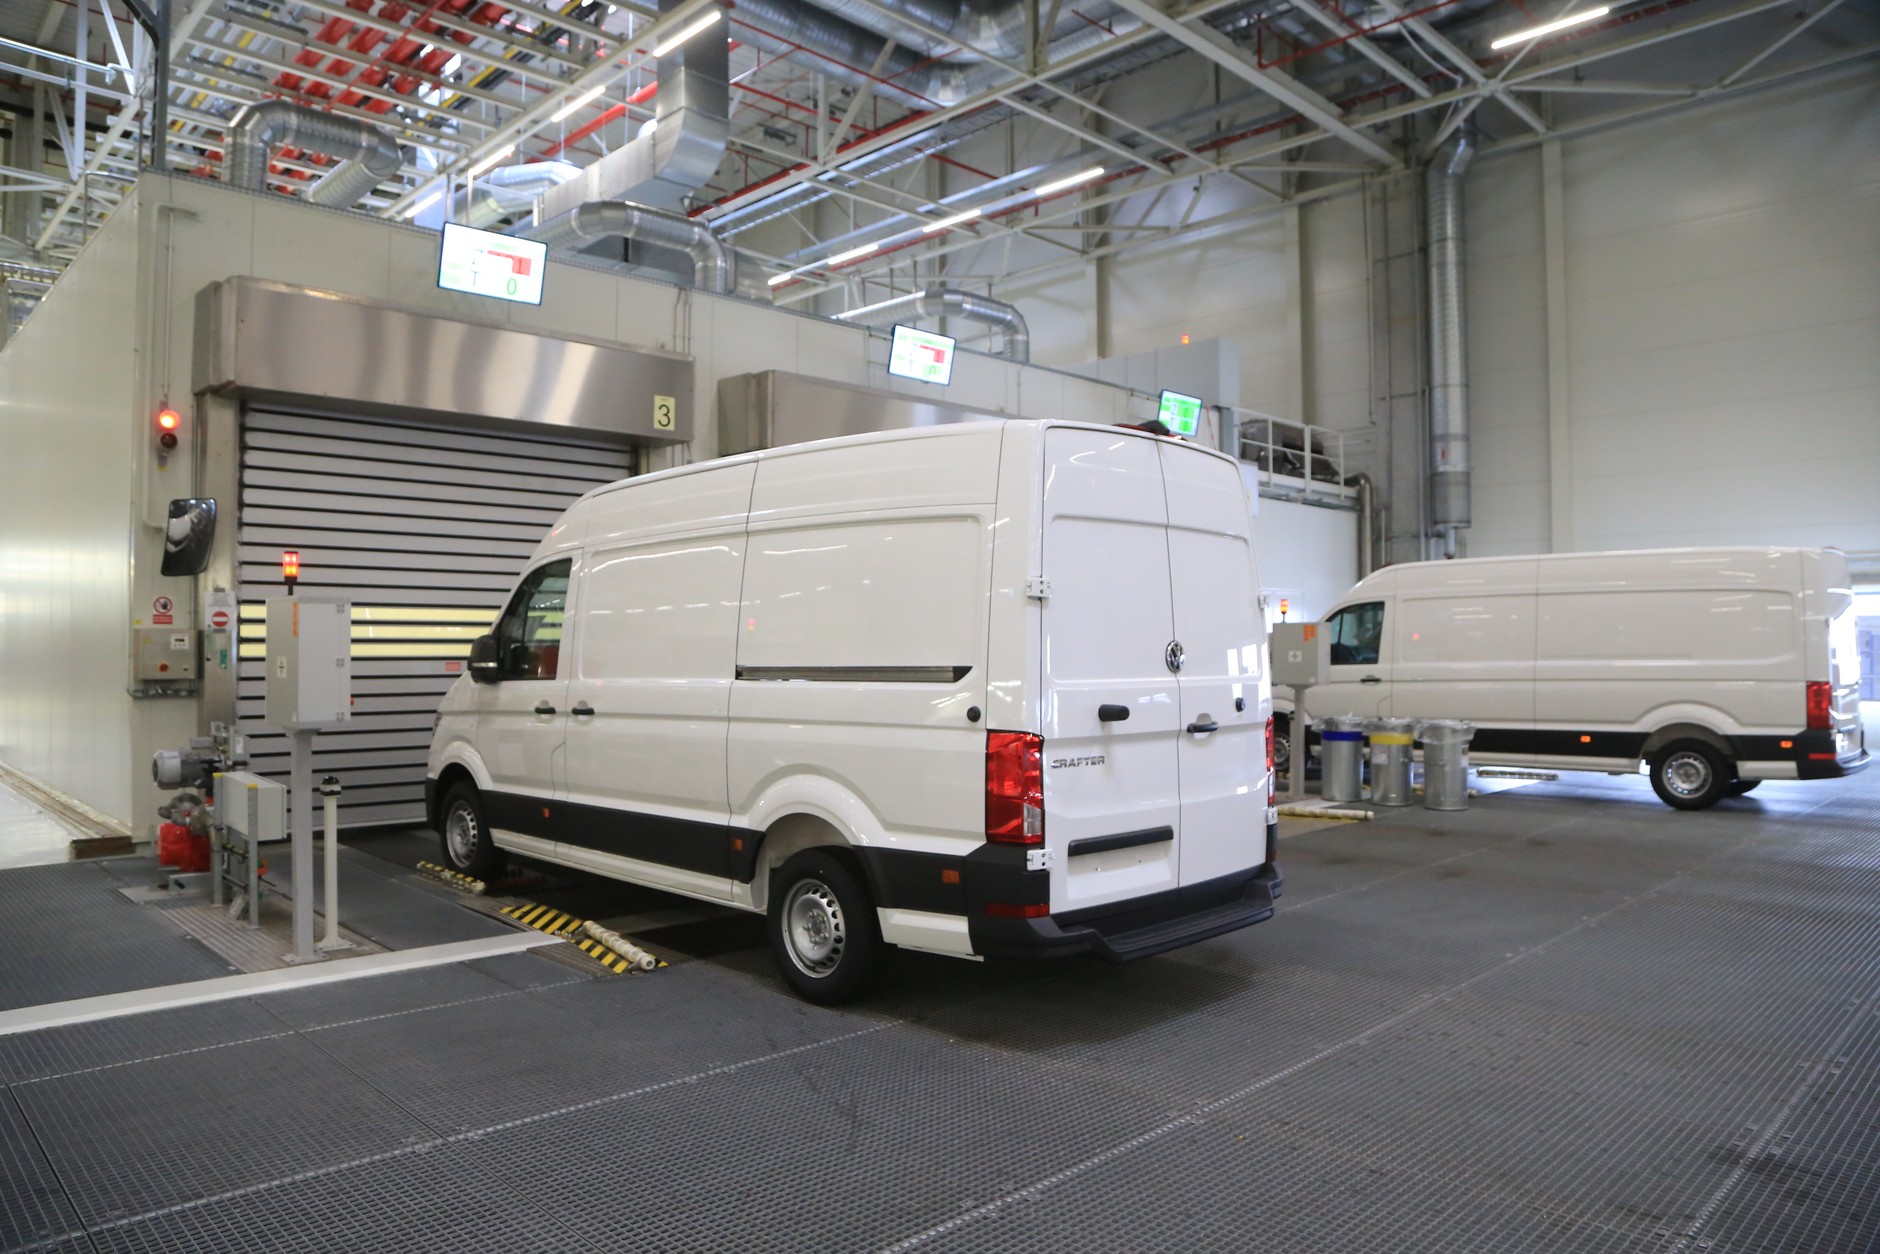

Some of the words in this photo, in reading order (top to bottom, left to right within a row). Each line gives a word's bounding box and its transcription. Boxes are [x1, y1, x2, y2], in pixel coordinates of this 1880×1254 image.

[506, 278, 518, 296] 0
[658, 404, 671, 427] 3
[1050, 755, 1105, 769] CRAFTER
